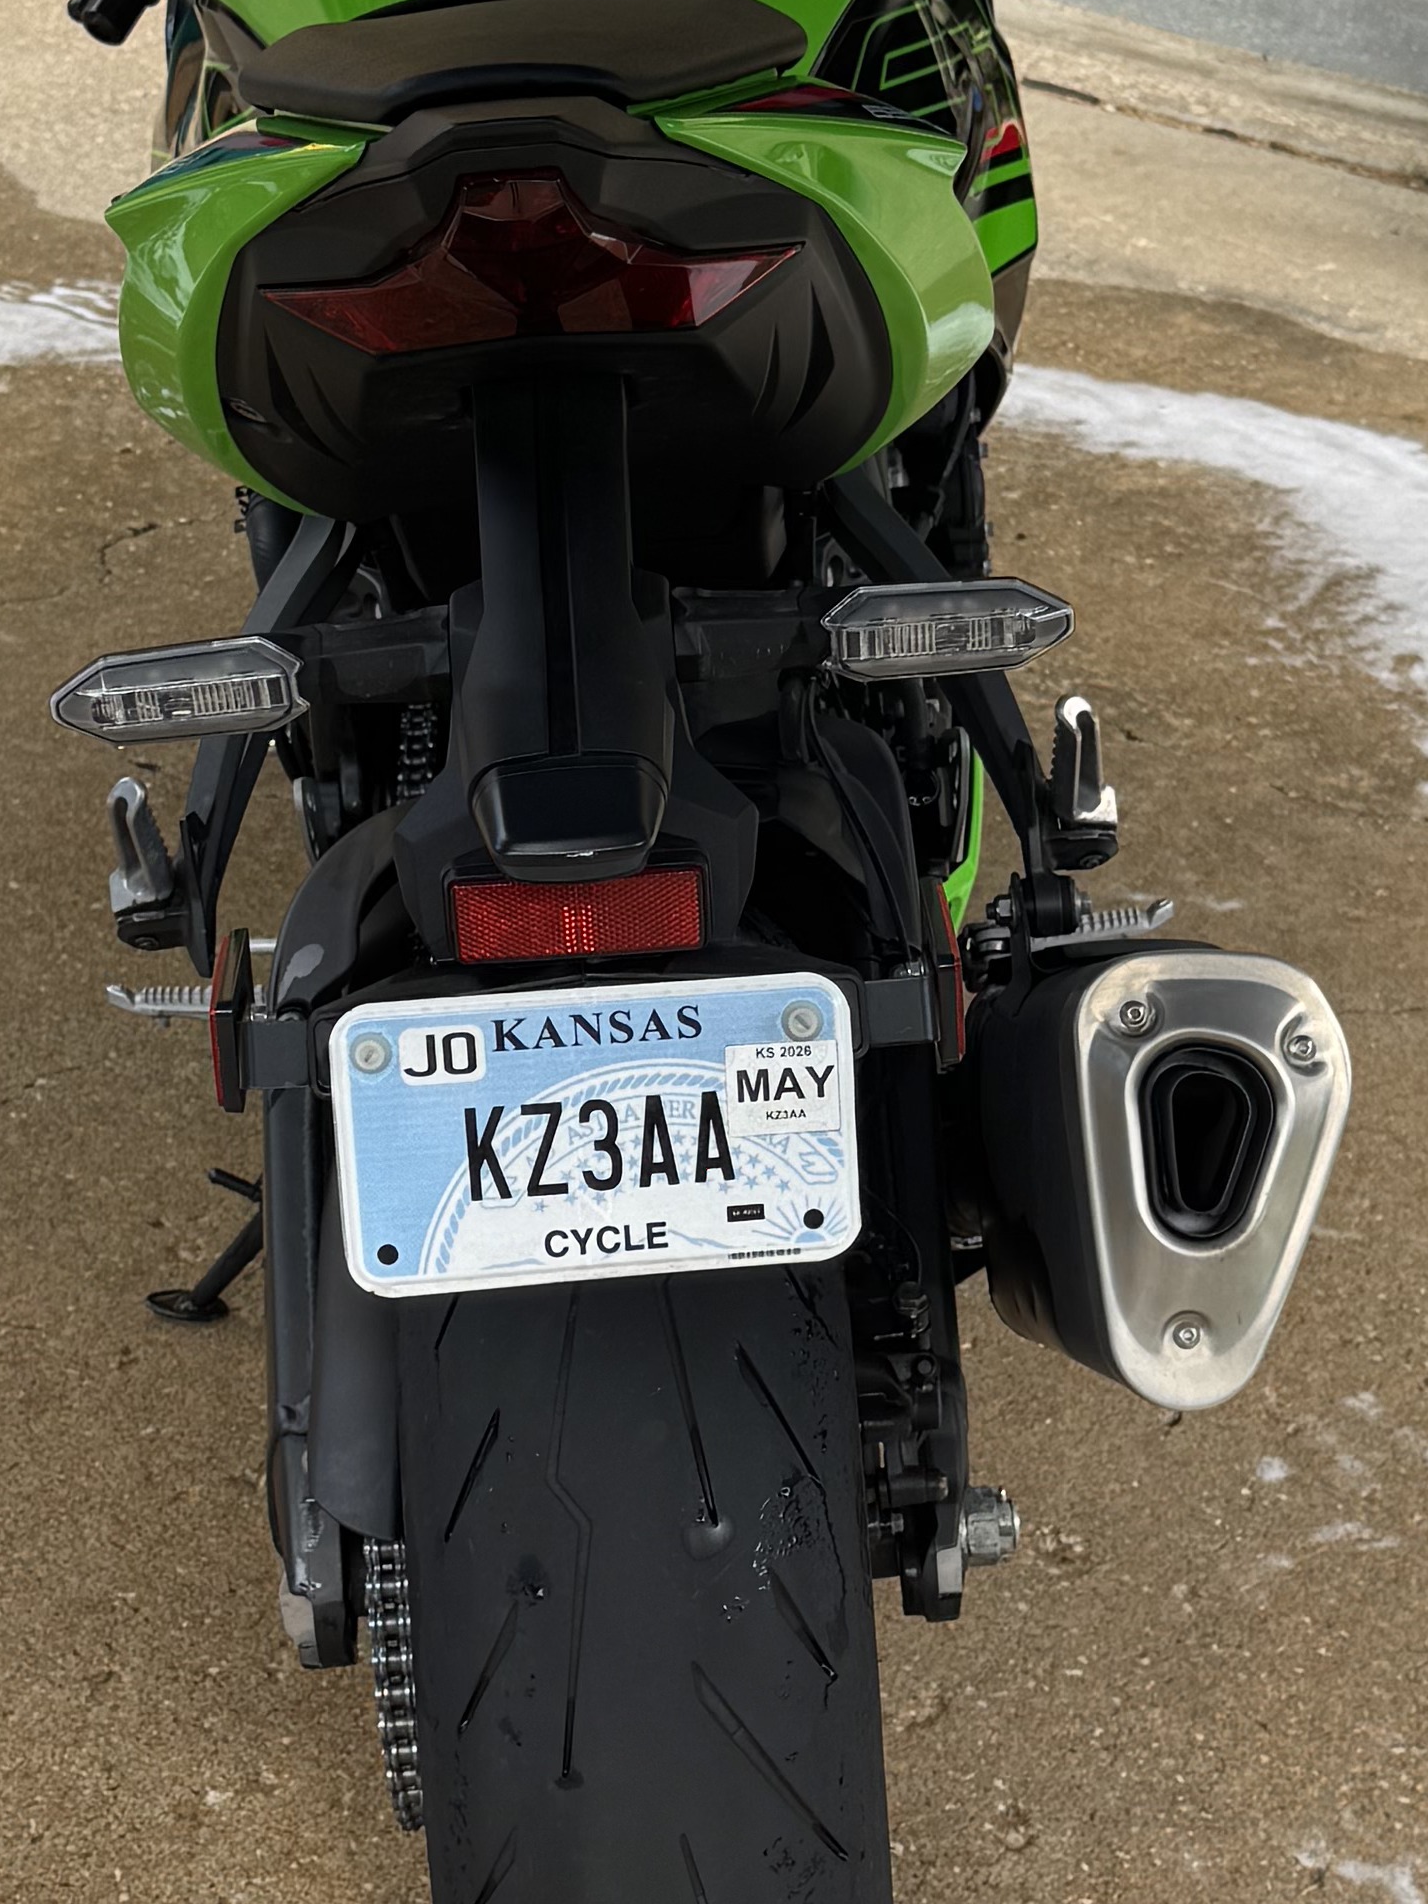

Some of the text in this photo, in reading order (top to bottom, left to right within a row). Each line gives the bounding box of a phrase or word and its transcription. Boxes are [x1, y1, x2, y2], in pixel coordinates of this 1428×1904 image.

[490, 1005, 703, 1053] KANSAS
[404, 1032, 478, 1077] JO
[756, 1047, 775, 1059] KS
[736, 1065, 834, 1103] MAY
[464, 1091, 735, 1201] KZ3AA
[544, 1221, 669, 1258] CYCLE
